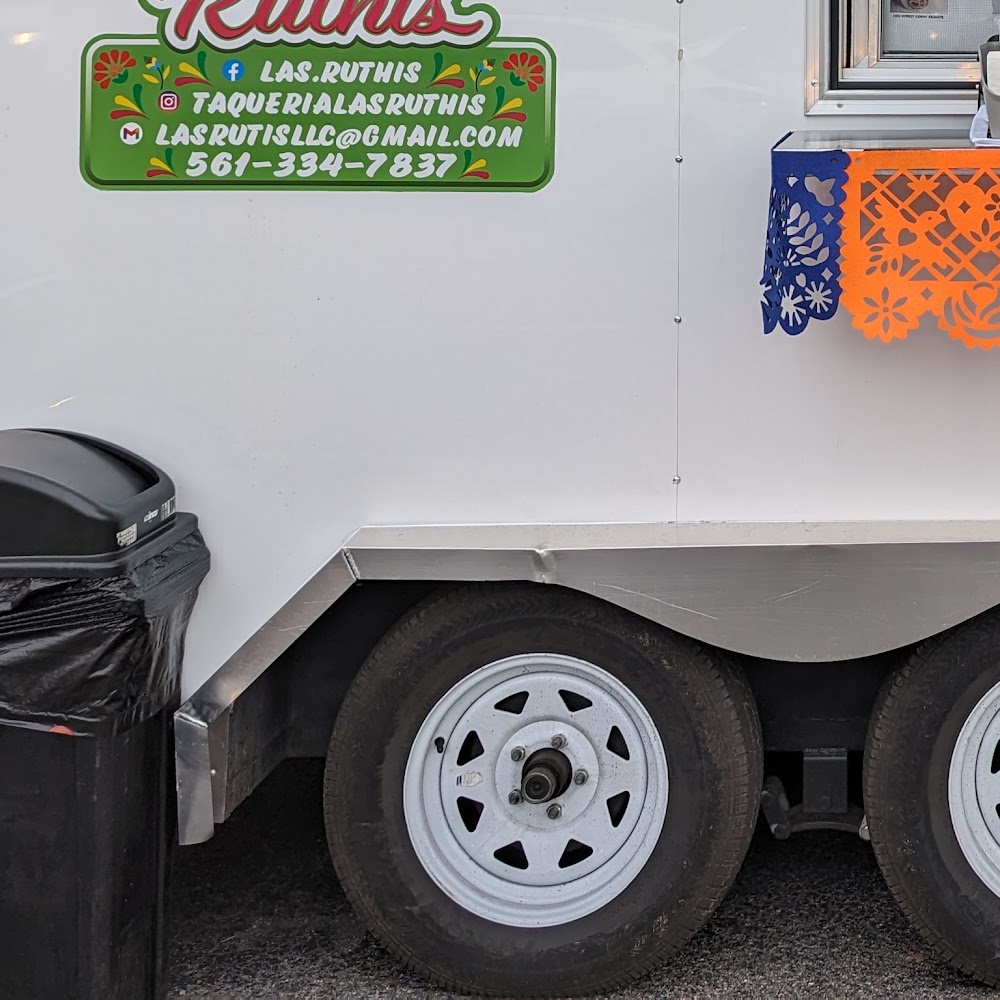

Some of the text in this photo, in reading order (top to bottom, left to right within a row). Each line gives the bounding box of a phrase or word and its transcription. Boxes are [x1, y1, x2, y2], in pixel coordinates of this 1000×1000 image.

[259, 60, 422, 84] LAS.RUTHIS
[192, 91, 486, 117] TAQUERIALASRUTHIS
[155, 122, 523, 149] LASRUTISLLC@GMAIL.COM
[185, 151, 458, 179] 561-334-7837
